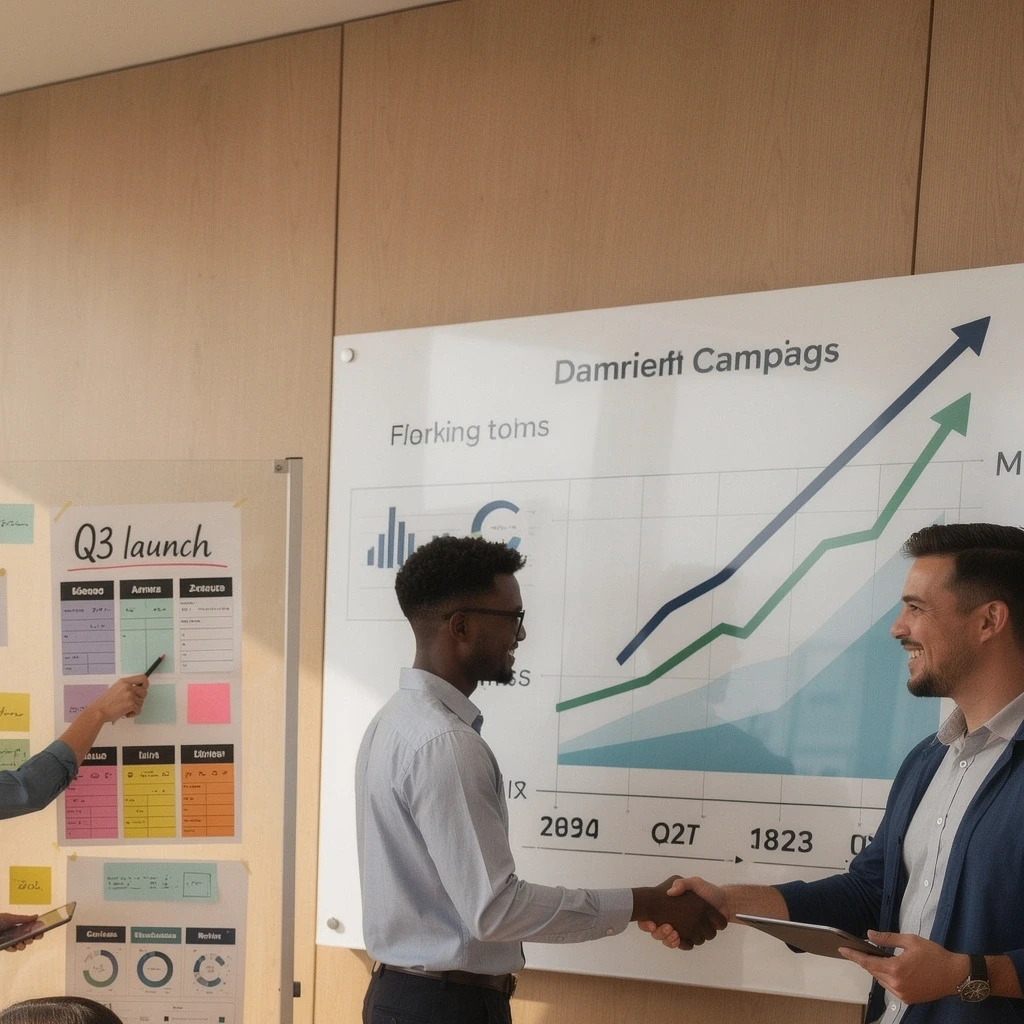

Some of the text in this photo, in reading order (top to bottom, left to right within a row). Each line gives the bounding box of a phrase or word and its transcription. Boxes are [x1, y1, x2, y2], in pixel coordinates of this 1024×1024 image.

[74, 523, 212, 563] Q3 launch
[651, 822, 701, 847] Q2T
